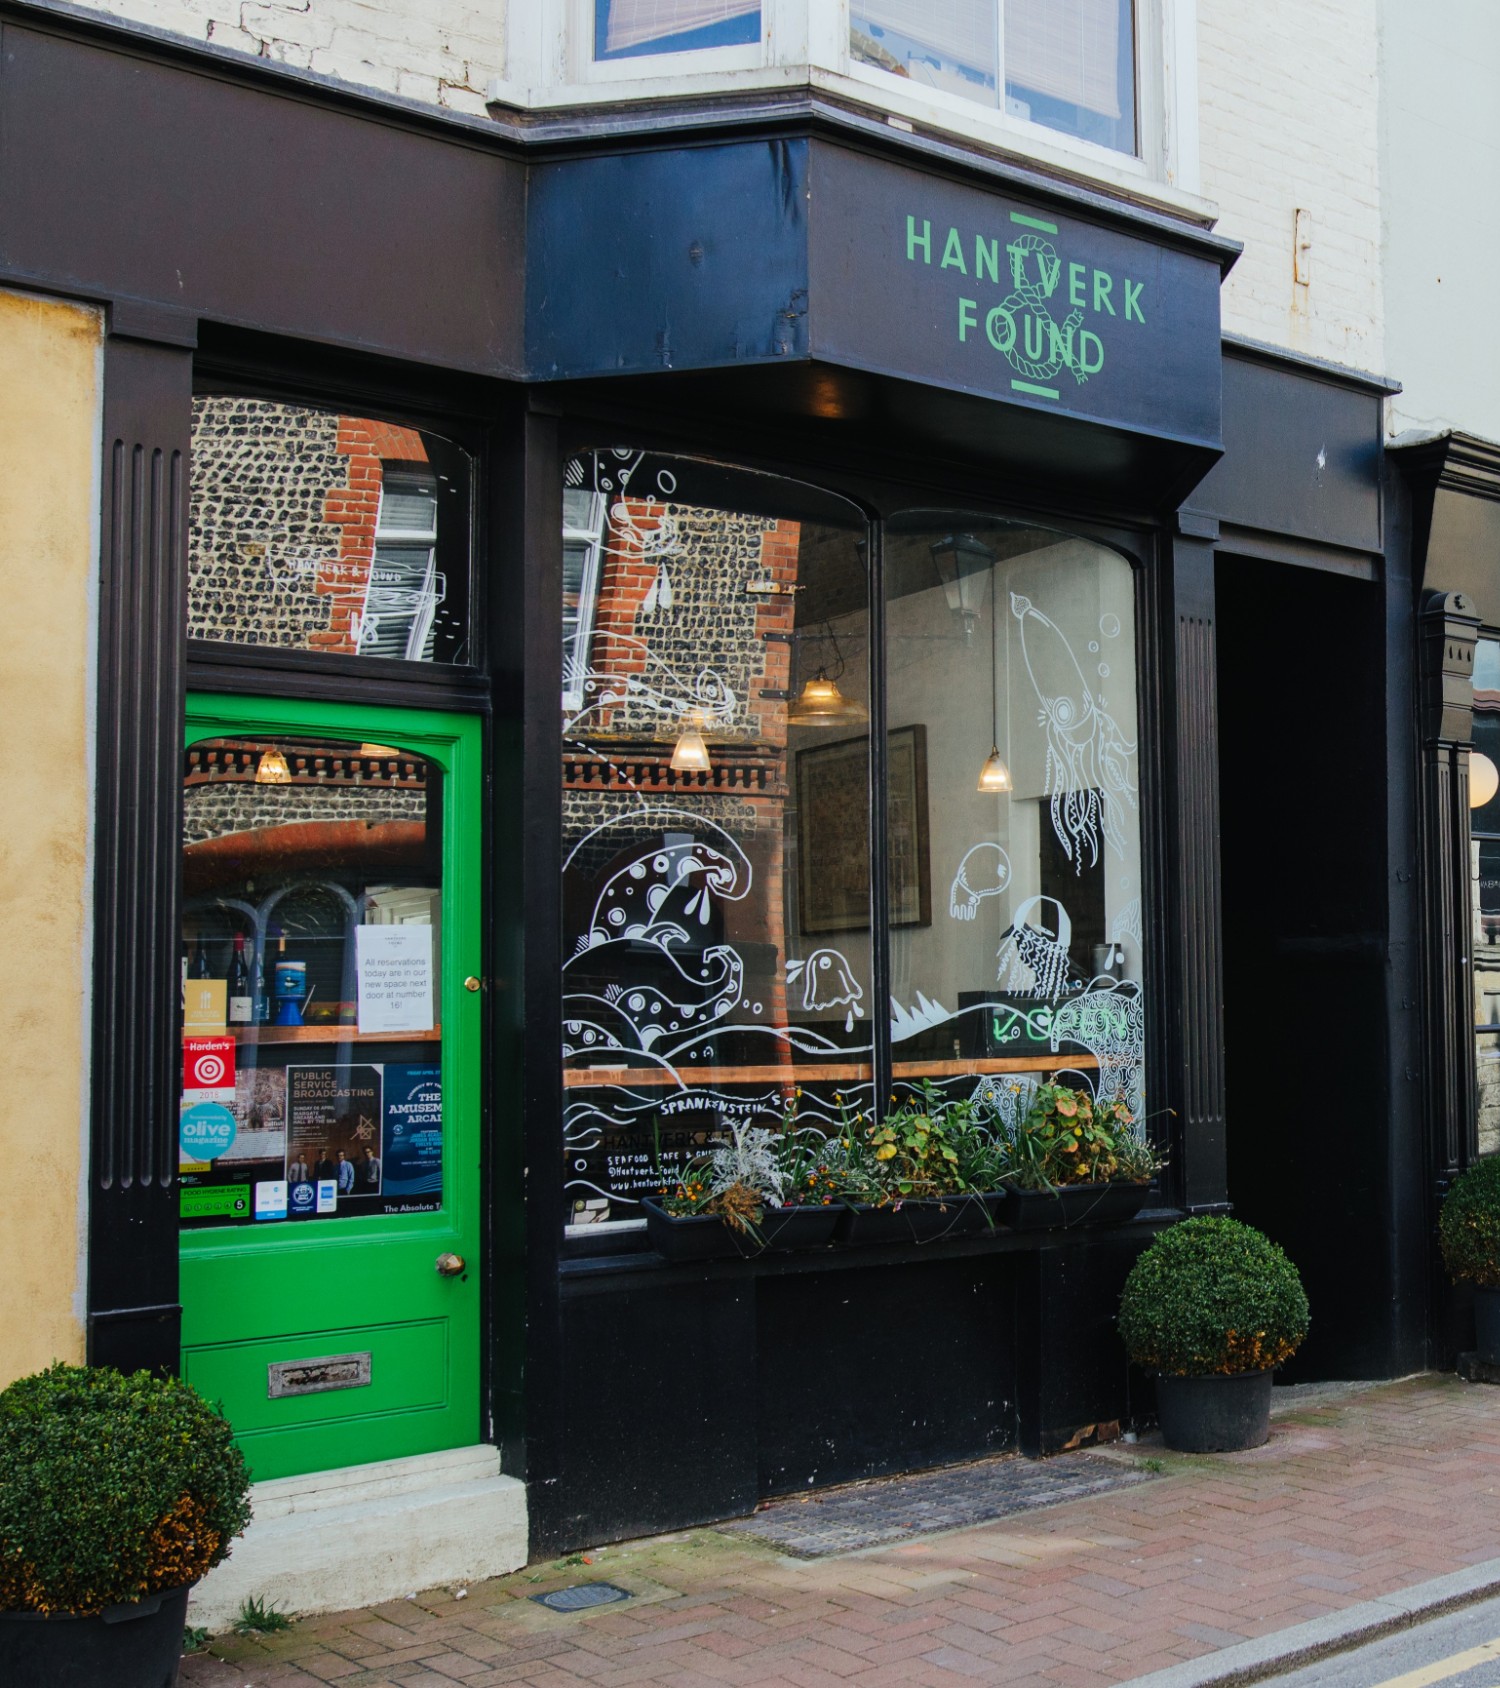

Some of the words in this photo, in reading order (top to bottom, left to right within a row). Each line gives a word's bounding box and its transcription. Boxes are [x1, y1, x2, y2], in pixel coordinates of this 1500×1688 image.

[907, 215, 1146, 324] HANTVERK
[958, 297, 1104, 373] FOUND
[288, 559, 350, 576] HANTVERK
[363, 570, 402, 582] FOUND
[350, 612, 380, 644] 18
[377, 958, 426, 966] reservations
[364, 970, 387, 978] today
[384, 981, 408, 989] space
[396, 991, 426, 999] number
[189, 1041, 230, 1051] Harden's
[293, 1072, 332, 1081] PUBLIC
[293, 1080, 338, 1090] SERVICE
[293, 1088, 375, 1098] BROADCASTING
[418, 1093, 441, 1102] THE
[183, 1121, 231, 1136] olive
[183, 1137, 229, 1145] magazine
[607, 1154, 649, 1166] SEAFOOD
[236, 1200, 243, 1209] 5
[384, 1205, 399, 1213] The
[399, 1203, 434, 1212] Absolute
